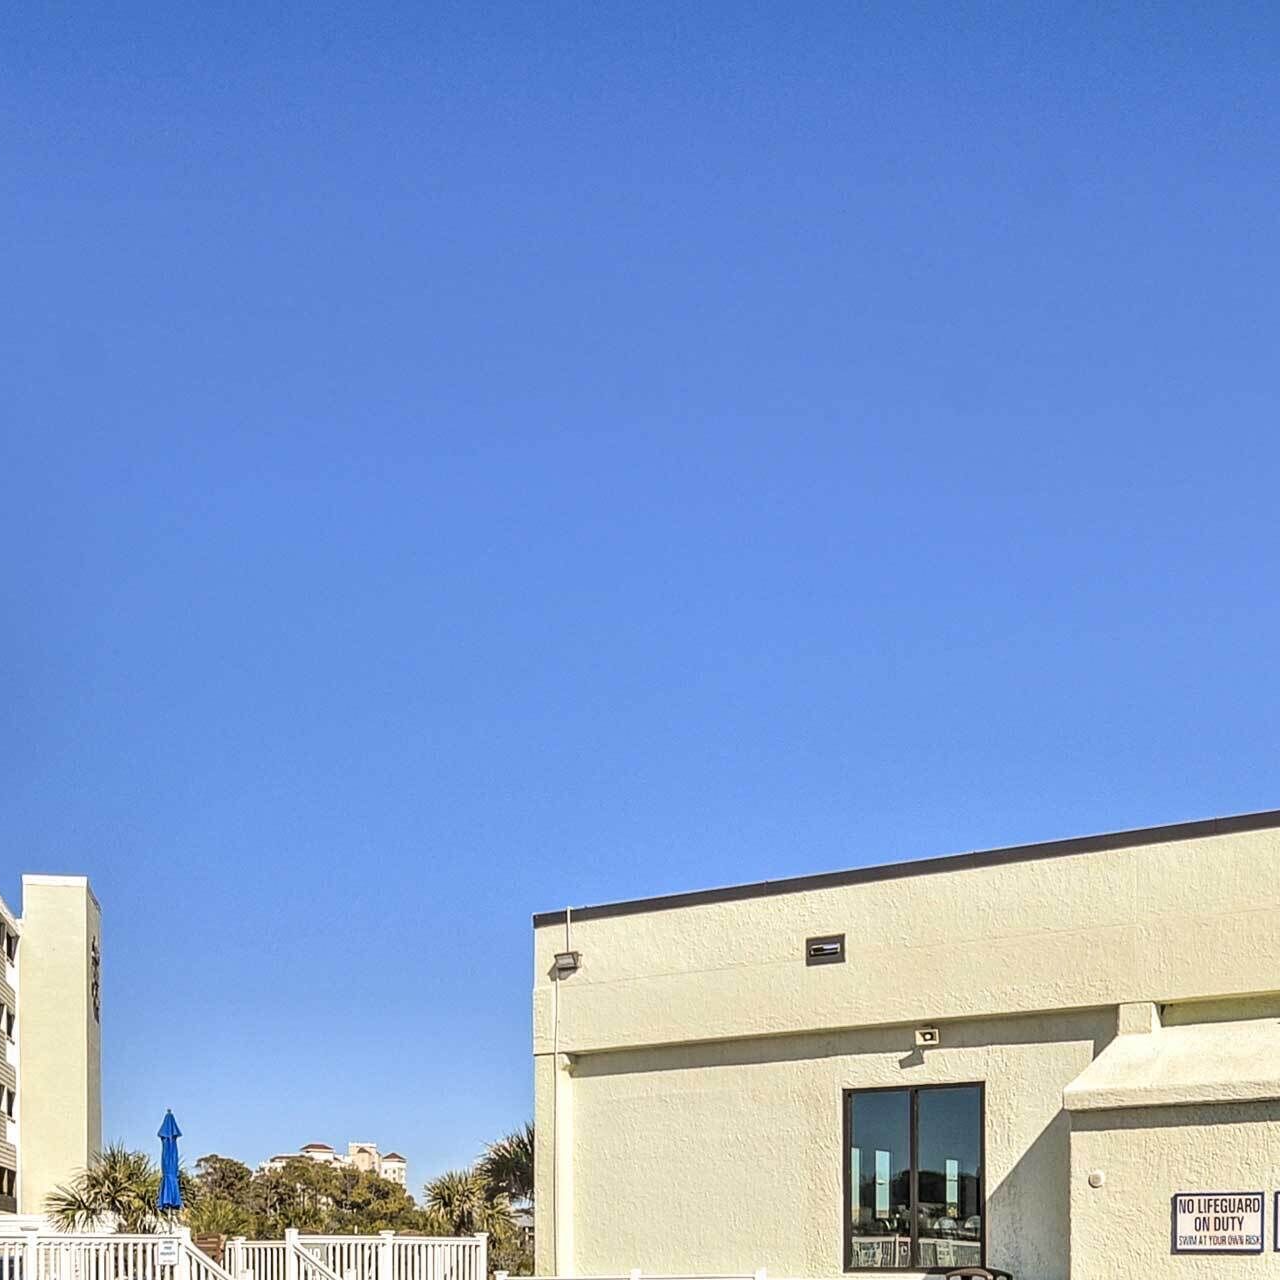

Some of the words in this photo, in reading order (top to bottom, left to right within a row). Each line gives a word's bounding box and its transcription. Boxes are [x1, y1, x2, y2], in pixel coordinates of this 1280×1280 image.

[1179, 1199, 1194, 1214] NO
[1198, 1198, 1260, 1214] LIFEGUARD
[1194, 1216, 1210, 1232] ON
[1214, 1216, 1245, 1232] DUTY
[1178, 1235, 1197, 1246] SWIM
[1198, 1235, 1207, 1246] AT
[1208, 1235, 1226, 1246] YOUR
[1227, 1235, 1245, 1246] OWN
